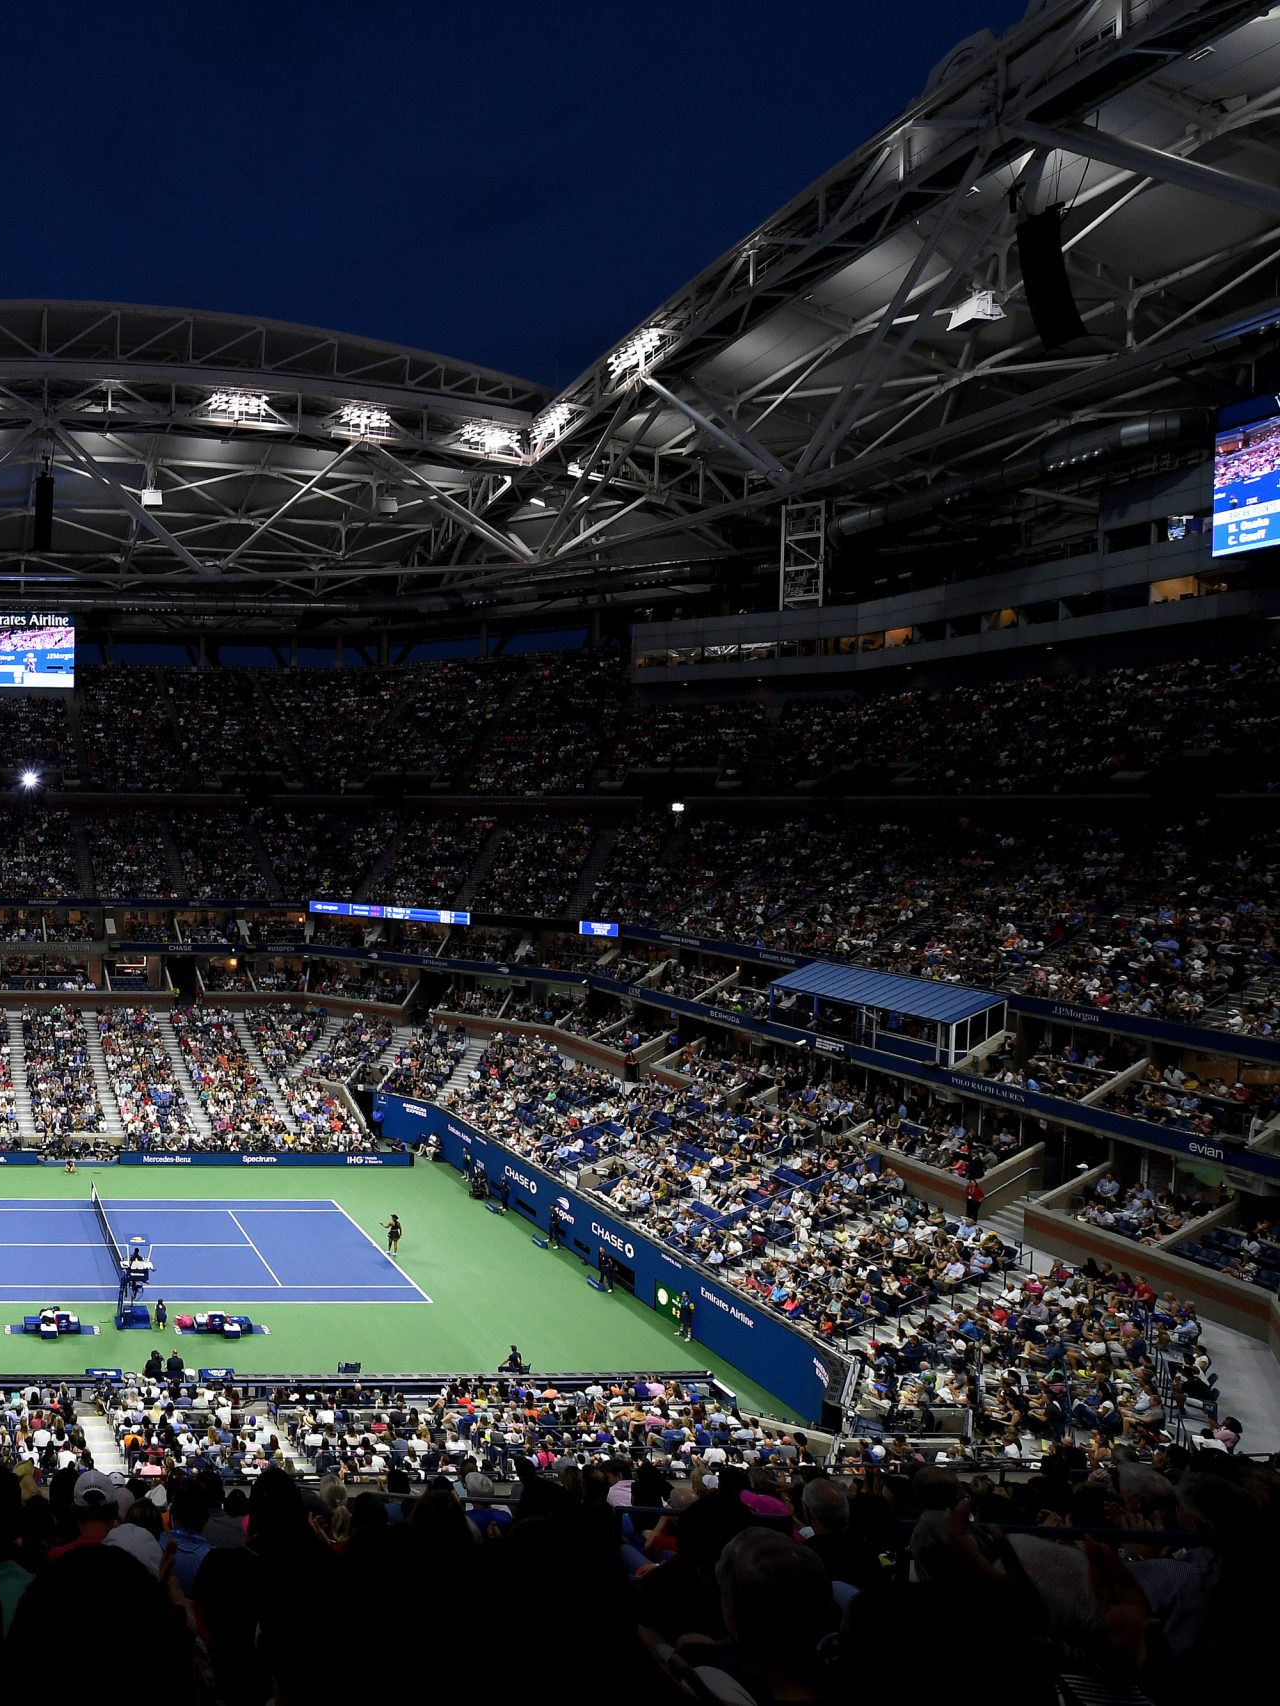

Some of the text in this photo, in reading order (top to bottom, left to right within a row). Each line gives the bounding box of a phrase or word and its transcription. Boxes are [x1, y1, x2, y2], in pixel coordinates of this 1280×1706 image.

[29, 614, 69, 626] Airline
[709, 1010, 740, 1025] BERMUDA
[1051, 1006, 1100, 1024] J.P.Morgan
[815, 1037, 846, 1053] ESPN
[951, 1076, 1025, 1103] POLO RALPH LAUREN
[142, 1155, 192, 1163] Mercedes-Benz
[1188, 1142, 1224, 1160] evian
[242, 1155, 277, 1164] Spectrum
[346, 1156, 364, 1164] IHG
[504, 1165, 530, 1190] CHASE
[558, 1210, 575, 1225] open
[591, 1222, 624, 1252] CHASE
[700, 1286, 754, 1329] Emirates Airline
